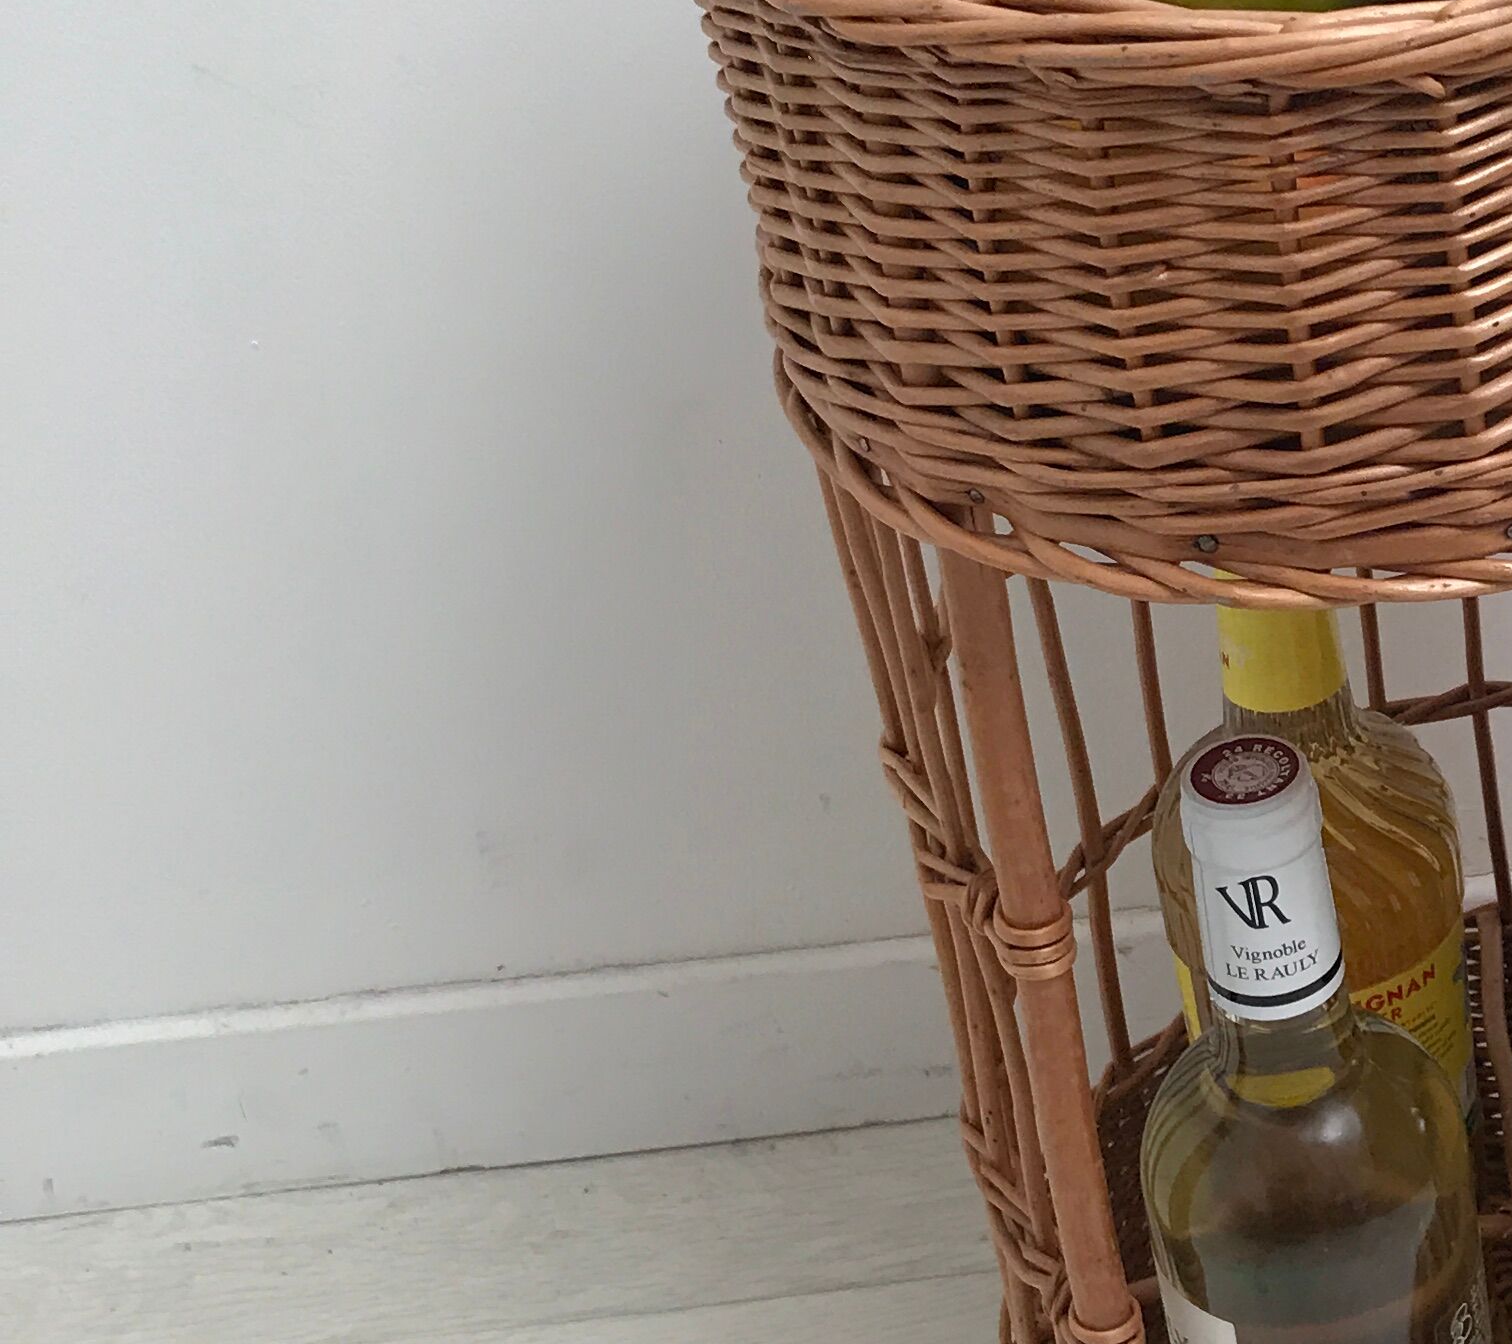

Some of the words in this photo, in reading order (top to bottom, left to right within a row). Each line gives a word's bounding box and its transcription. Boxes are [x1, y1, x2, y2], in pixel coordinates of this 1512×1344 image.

[1225, 962, 1250, 981] LE
[1254, 949, 1320, 982] RAULY
[1230, 939, 1307, 964] Vignoble
